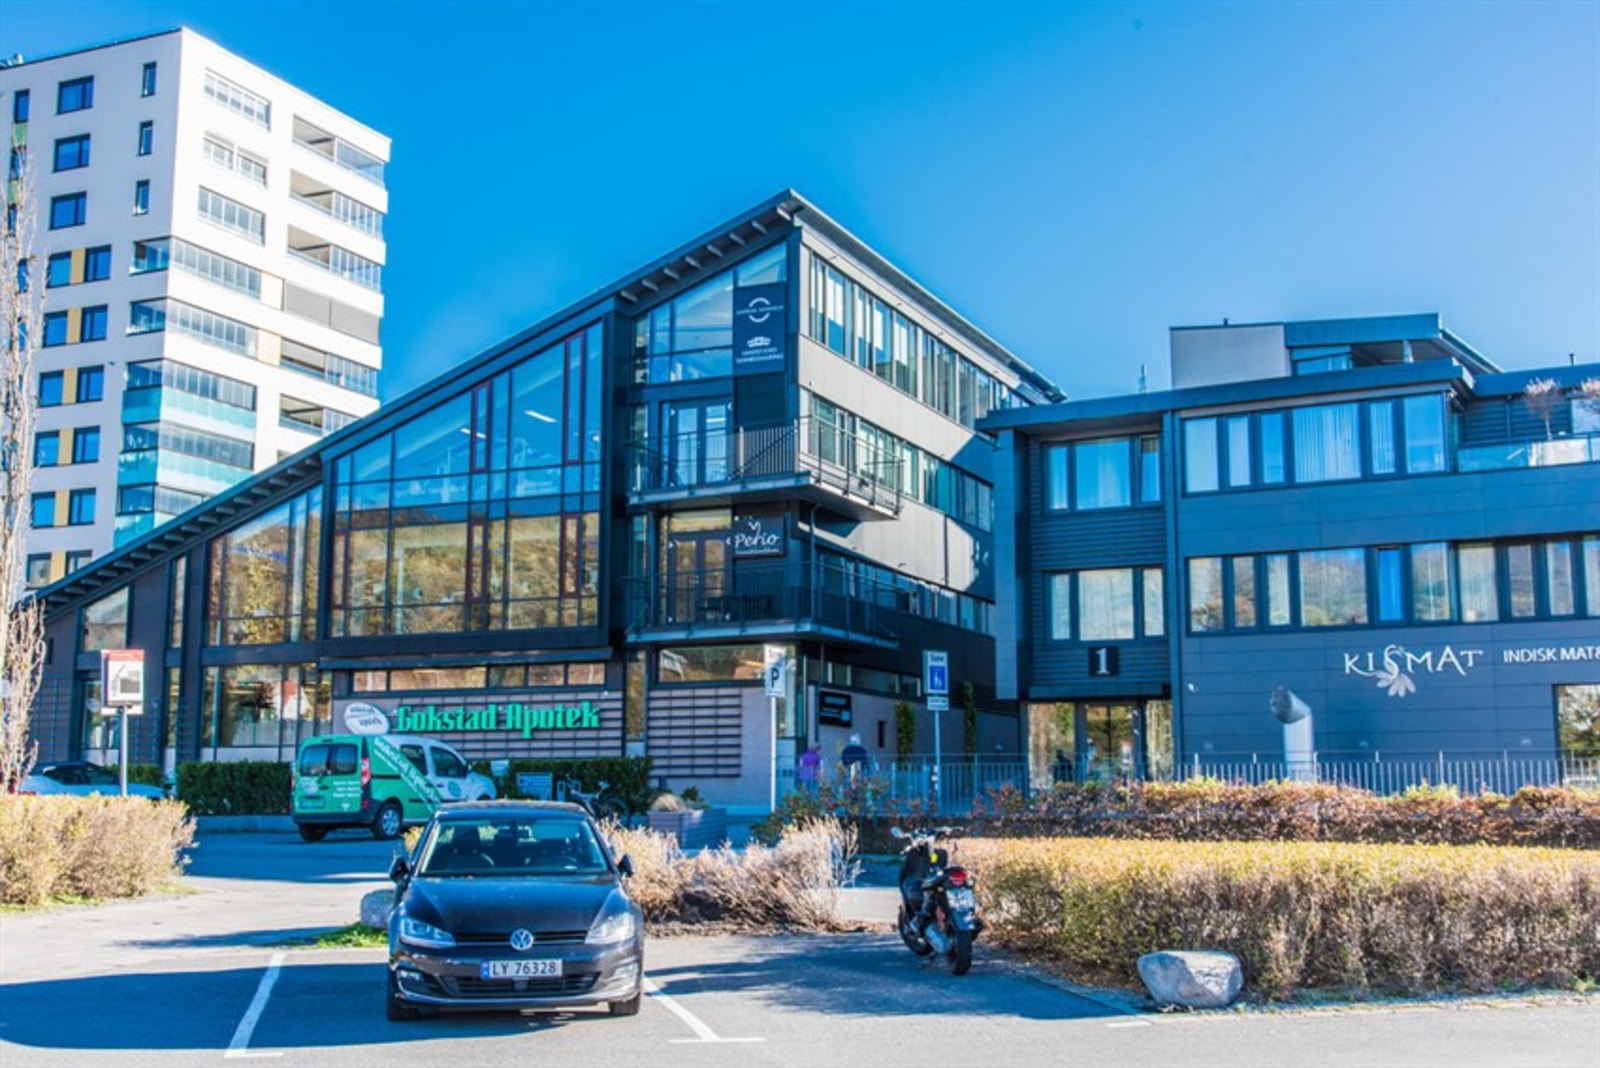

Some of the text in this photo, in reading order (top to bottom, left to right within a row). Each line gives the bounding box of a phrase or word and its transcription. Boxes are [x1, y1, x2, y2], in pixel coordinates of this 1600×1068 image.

[734, 530, 780, 548] Perio
[1095, 647, 1111, 675] 1
[1344, 644, 1484, 680] KISMAT
[1503, 647, 1557, 663] INDISK
[770, 667, 780, 688] P
[397, 701, 601, 739] Gokstad Apotek
[492, 962, 557, 975] LY 76328
